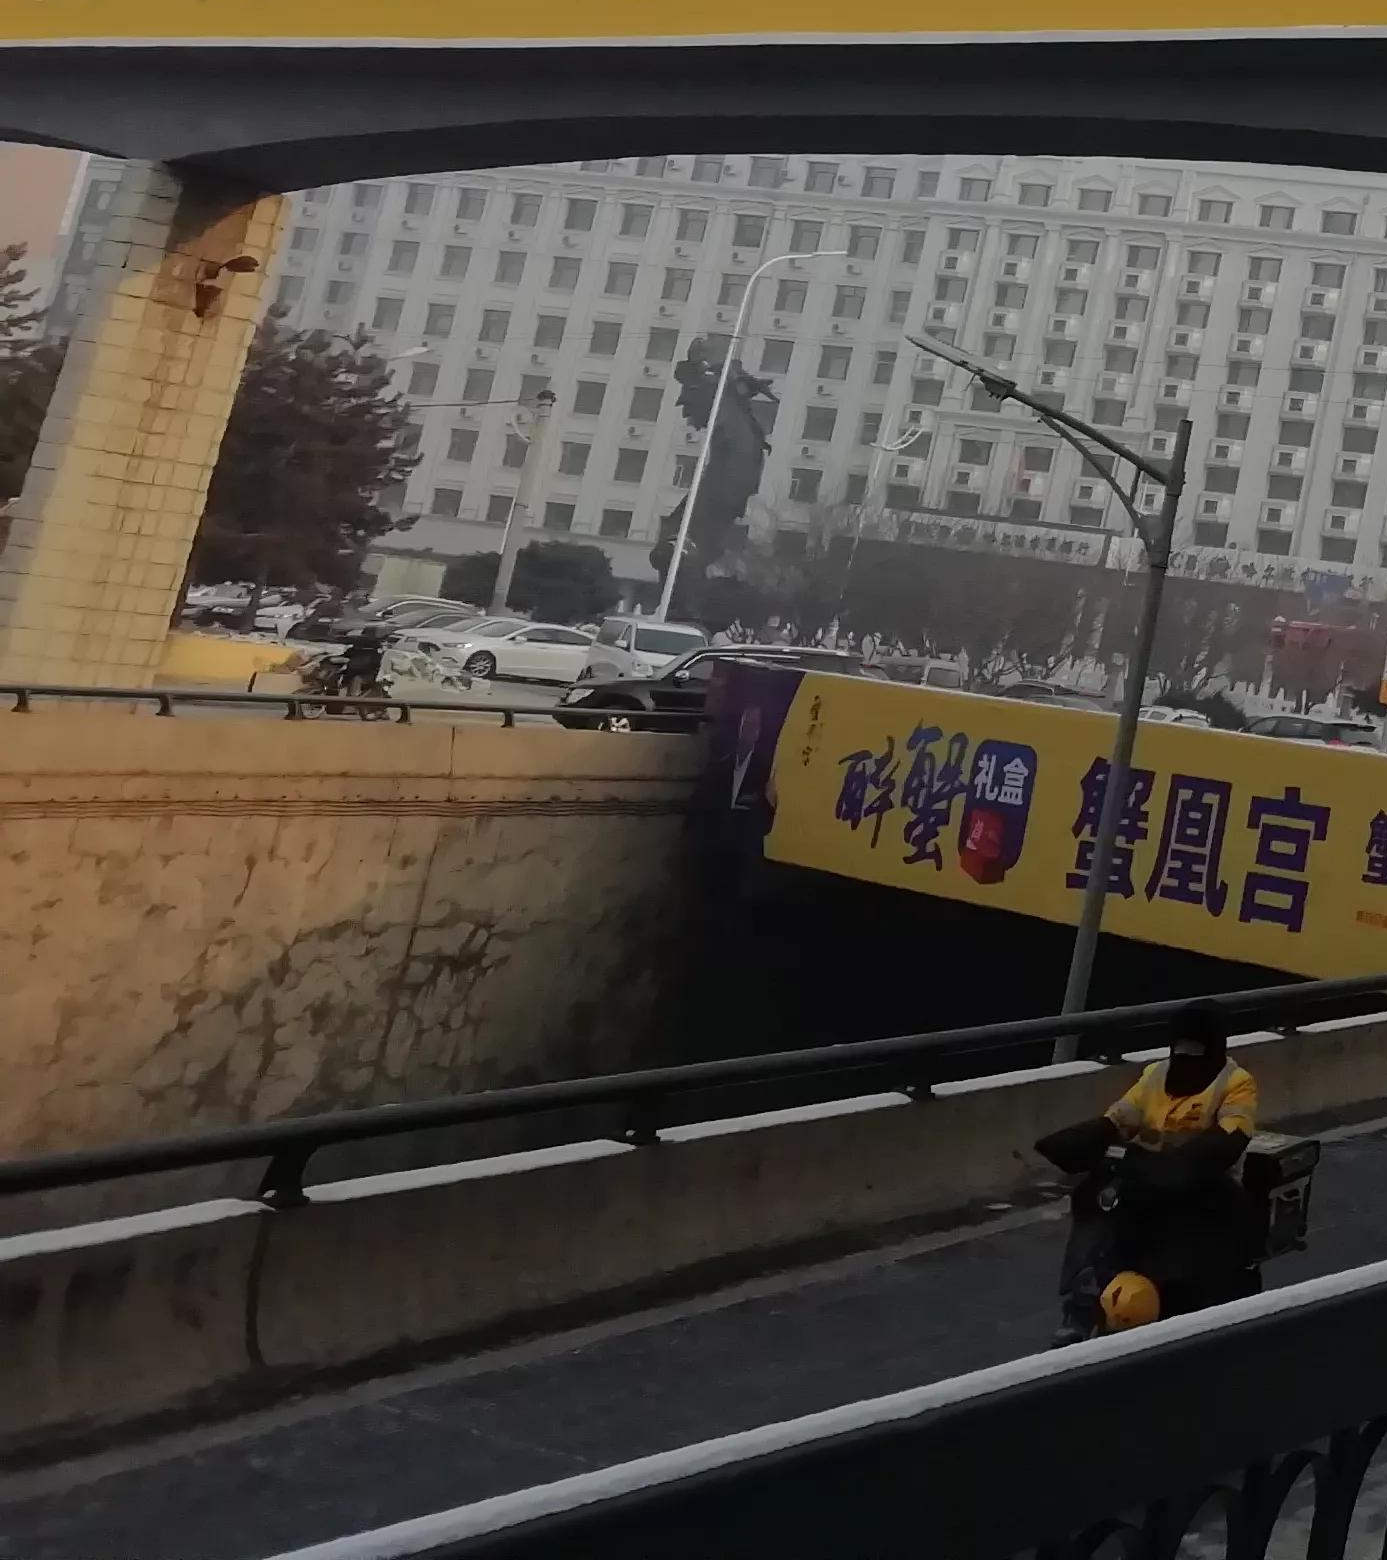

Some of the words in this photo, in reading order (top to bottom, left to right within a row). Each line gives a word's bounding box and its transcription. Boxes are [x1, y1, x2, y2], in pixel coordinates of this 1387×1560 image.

[974, 754, 1029, 806] 礼盒
[1066, 756, 1331, 933] 蟹凰宫
